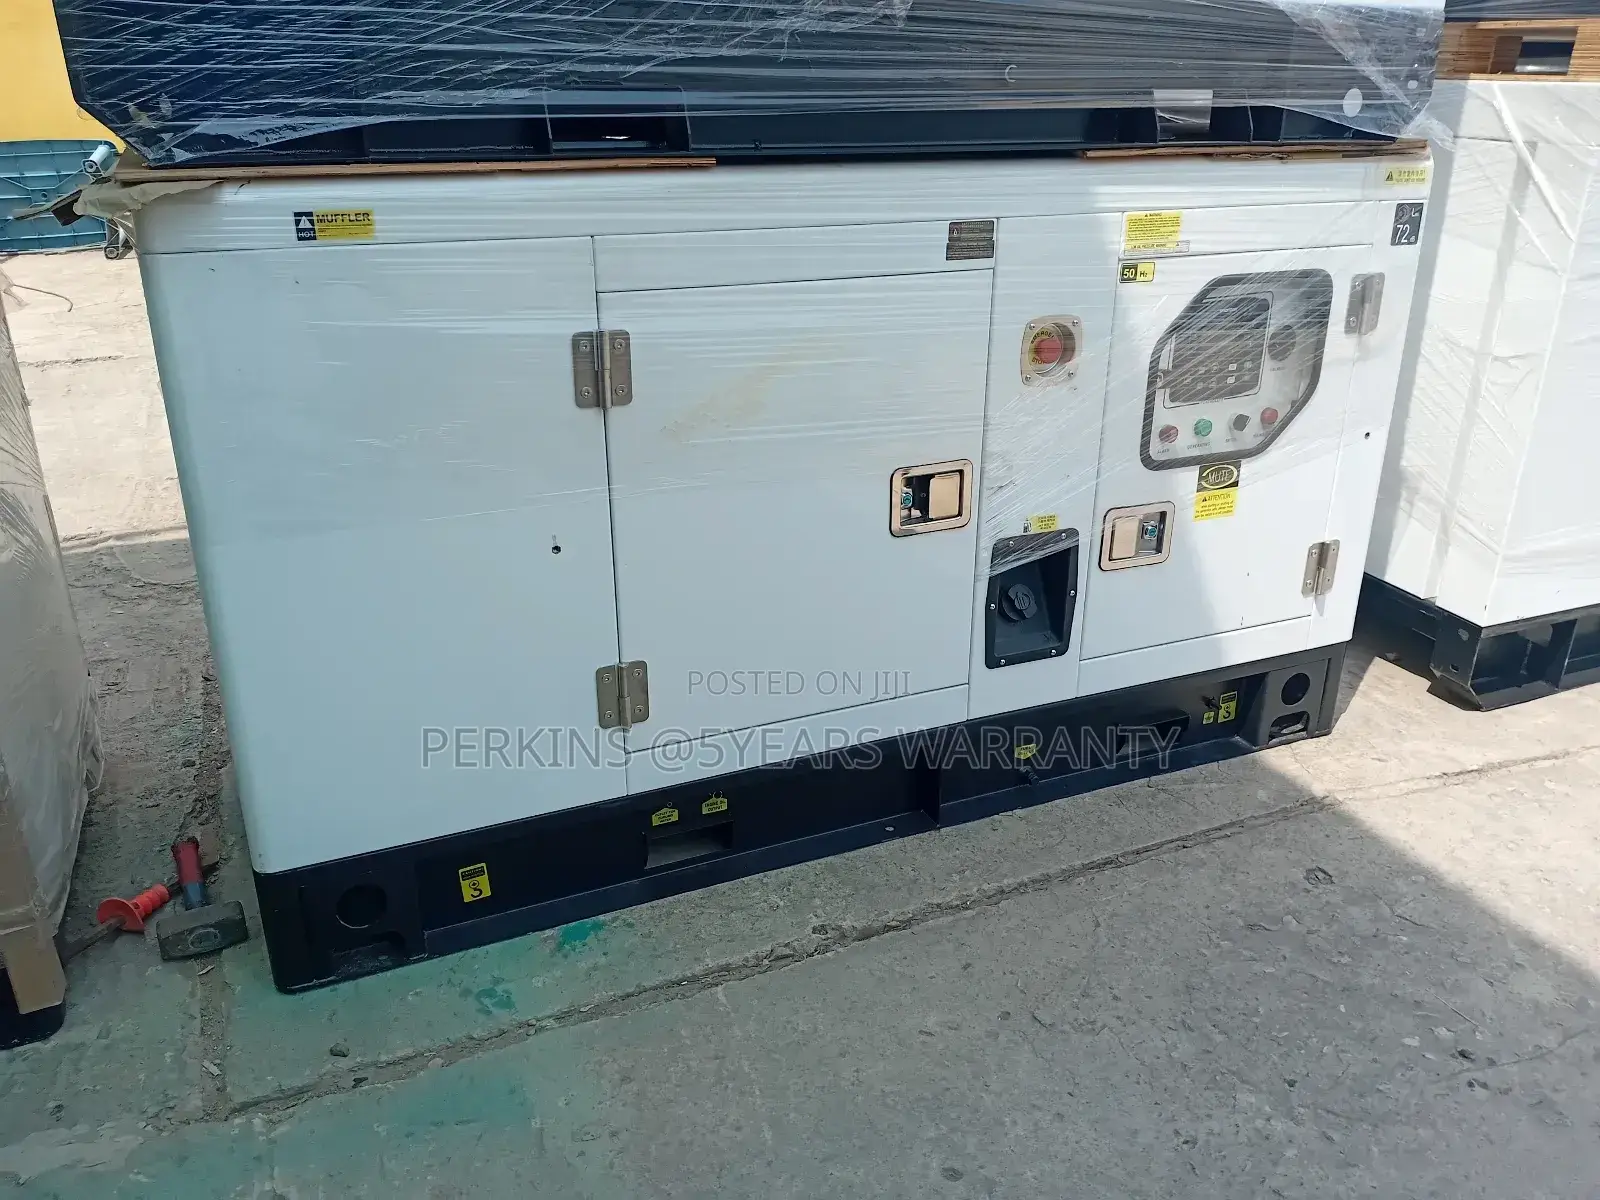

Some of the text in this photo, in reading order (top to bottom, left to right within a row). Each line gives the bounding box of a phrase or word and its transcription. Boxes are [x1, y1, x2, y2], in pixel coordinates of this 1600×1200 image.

[316, 213, 371, 223] MUFFLER
[1396, 224, 1410, 244] 72
[1123, 268, 1148, 279] 50 Hz
